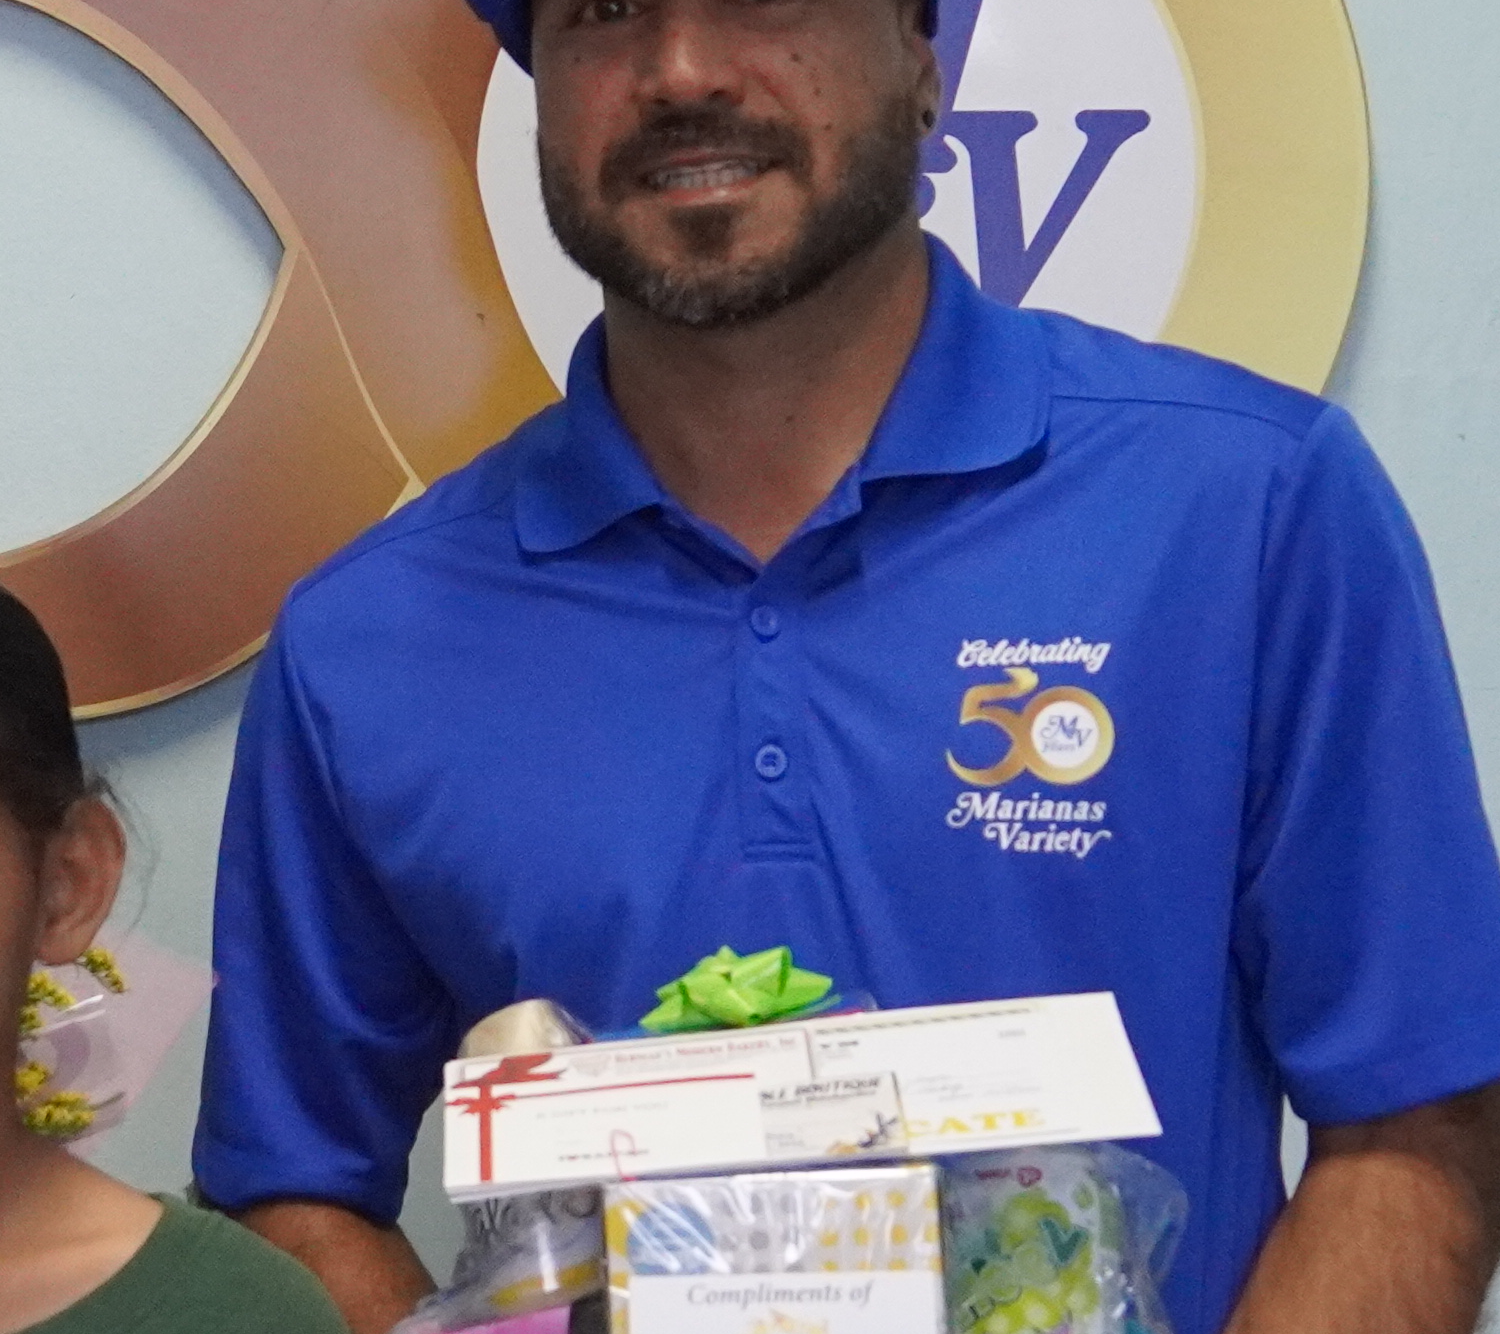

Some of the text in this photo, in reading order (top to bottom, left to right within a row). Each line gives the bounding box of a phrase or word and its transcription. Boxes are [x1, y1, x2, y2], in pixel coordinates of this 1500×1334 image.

[956, 636, 1112, 674] Celebrating
[946, 792, 1108, 829] Marianas
[982, 822, 1113, 859] Variety
[687, 1279, 875, 1310] Compliments of
